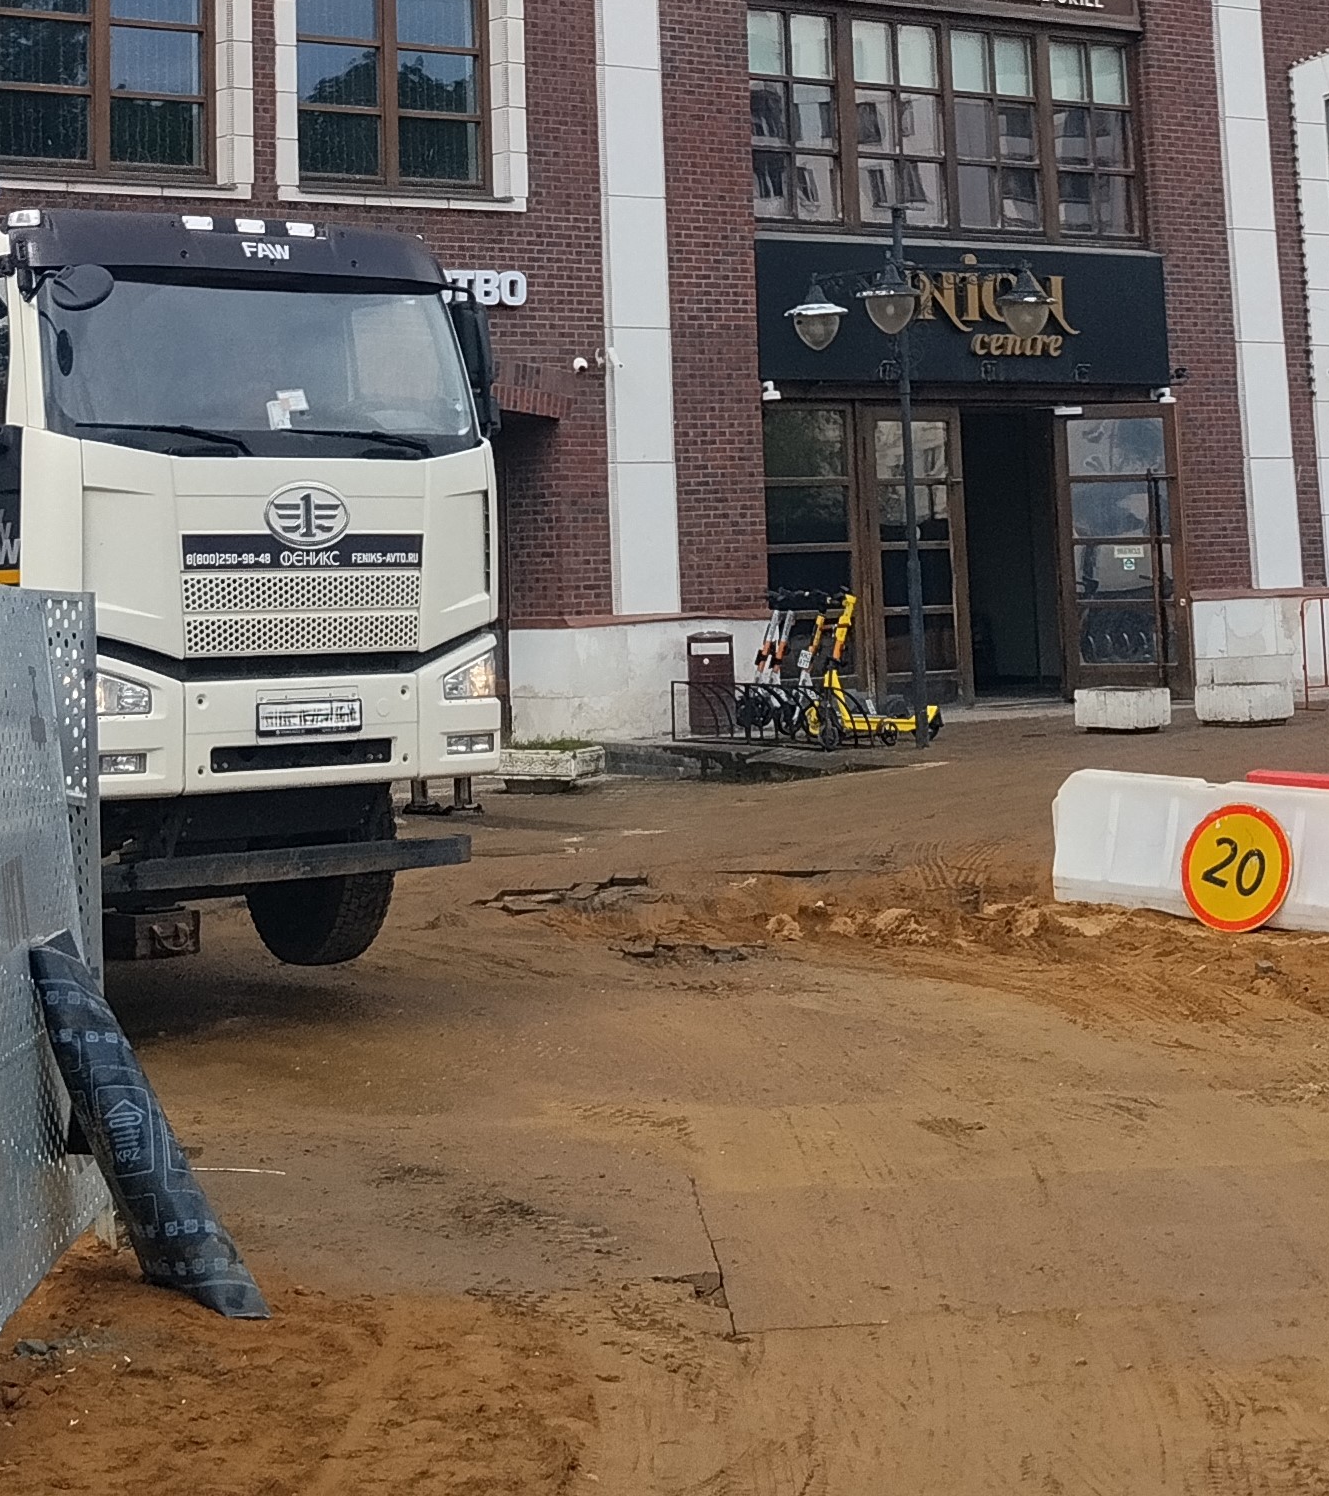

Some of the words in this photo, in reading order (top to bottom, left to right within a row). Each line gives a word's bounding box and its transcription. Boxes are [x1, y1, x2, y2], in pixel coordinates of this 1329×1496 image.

[241, 241, 290, 260] FAW
[441, 269, 528, 306] ТВО
[971, 333, 1064, 357] centre
[185, 551, 271, 567] 8(800)250-98-48
[279, 550, 341, 566] ФЕНИКС
[351, 552, 420, 564] FENIKS-AVTO.RU
[1201, 837, 1266, 897] 20
[115, 1146, 142, 1164] KRZ
